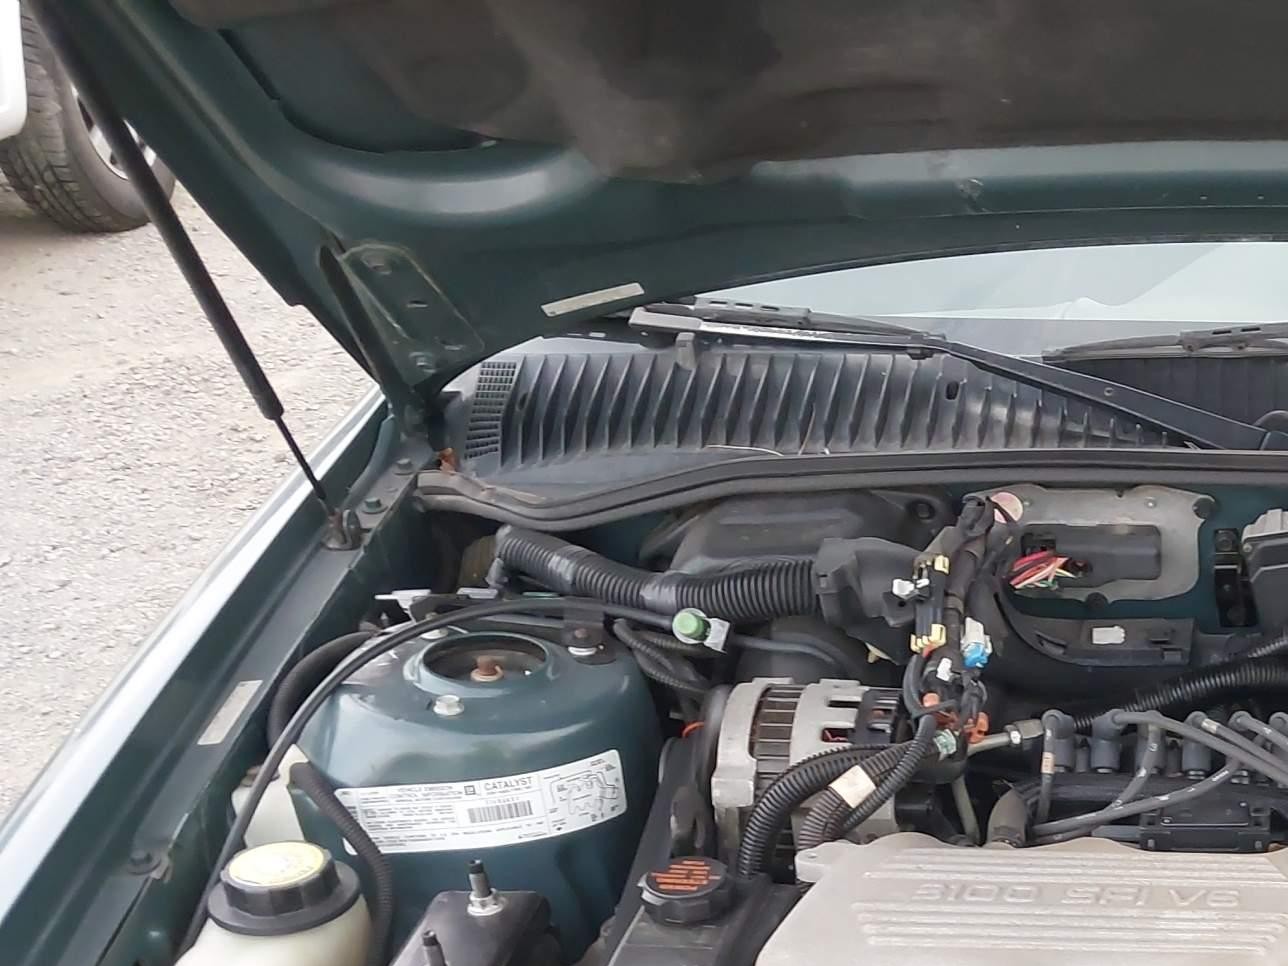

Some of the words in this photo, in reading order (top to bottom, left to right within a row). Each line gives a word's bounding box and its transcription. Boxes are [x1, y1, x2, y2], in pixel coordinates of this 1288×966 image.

[484, 776, 532, 791] CATALYST
[913, 884, 1038, 903] 3100
[1061, 885, 1150, 905] SFI
[1167, 889, 1240, 908] V6
